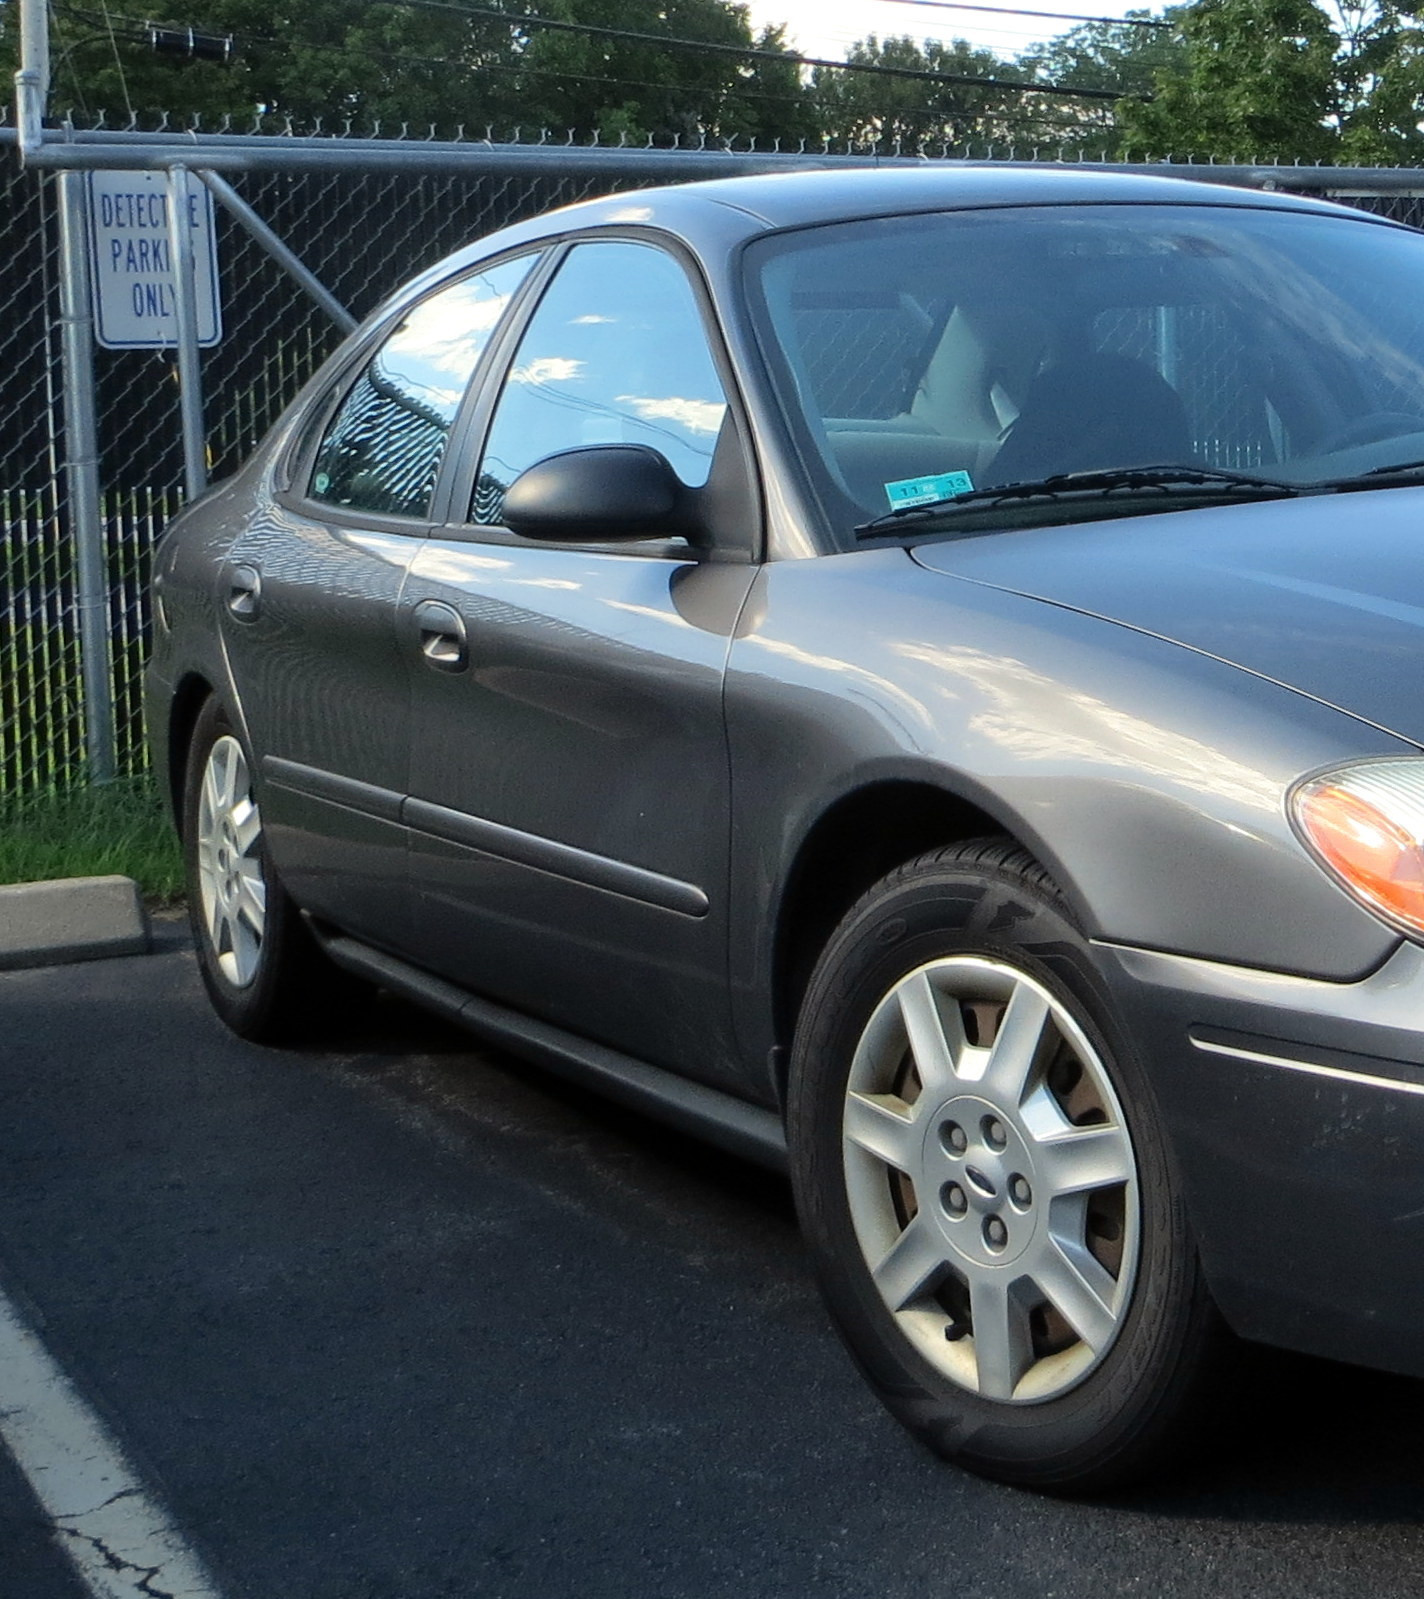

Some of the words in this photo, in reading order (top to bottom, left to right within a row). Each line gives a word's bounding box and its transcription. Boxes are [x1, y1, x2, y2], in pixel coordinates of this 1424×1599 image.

[101, 194, 199, 227] DETECTE
[111, 238, 196, 272] PARKI
[900, 486, 919, 497] 11
[946, 477, 967, 489] 13
